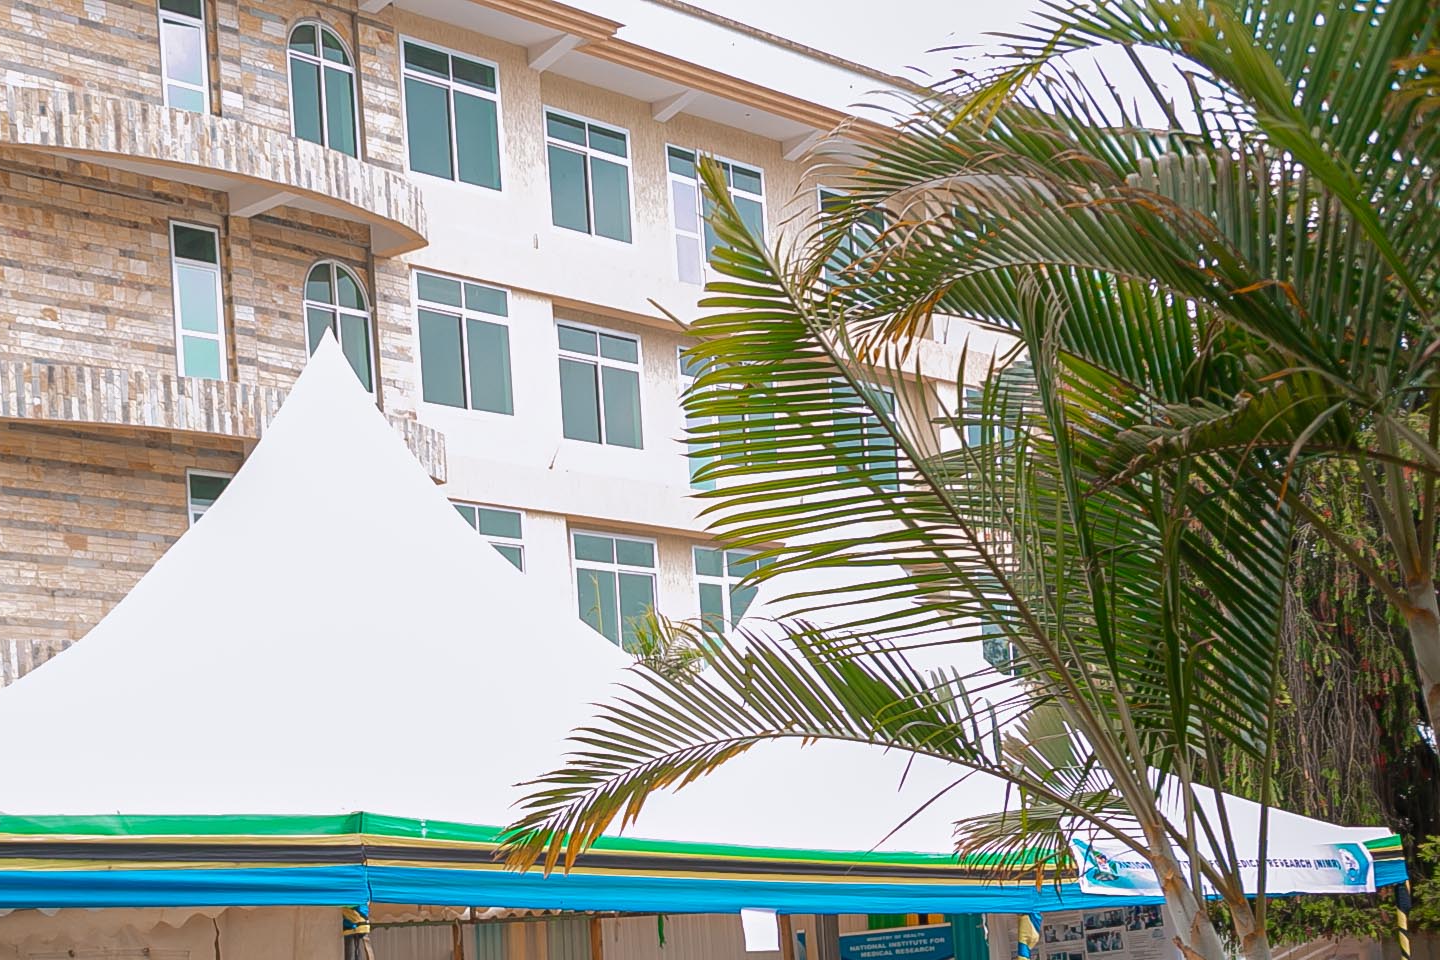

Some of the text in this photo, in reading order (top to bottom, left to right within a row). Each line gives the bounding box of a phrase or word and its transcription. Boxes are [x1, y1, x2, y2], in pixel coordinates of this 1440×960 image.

[849, 943, 887, 952] NATIONAL
[888, 938, 928, 948] INSTITUTE
[895, 946, 935, 955] RESEARCH
